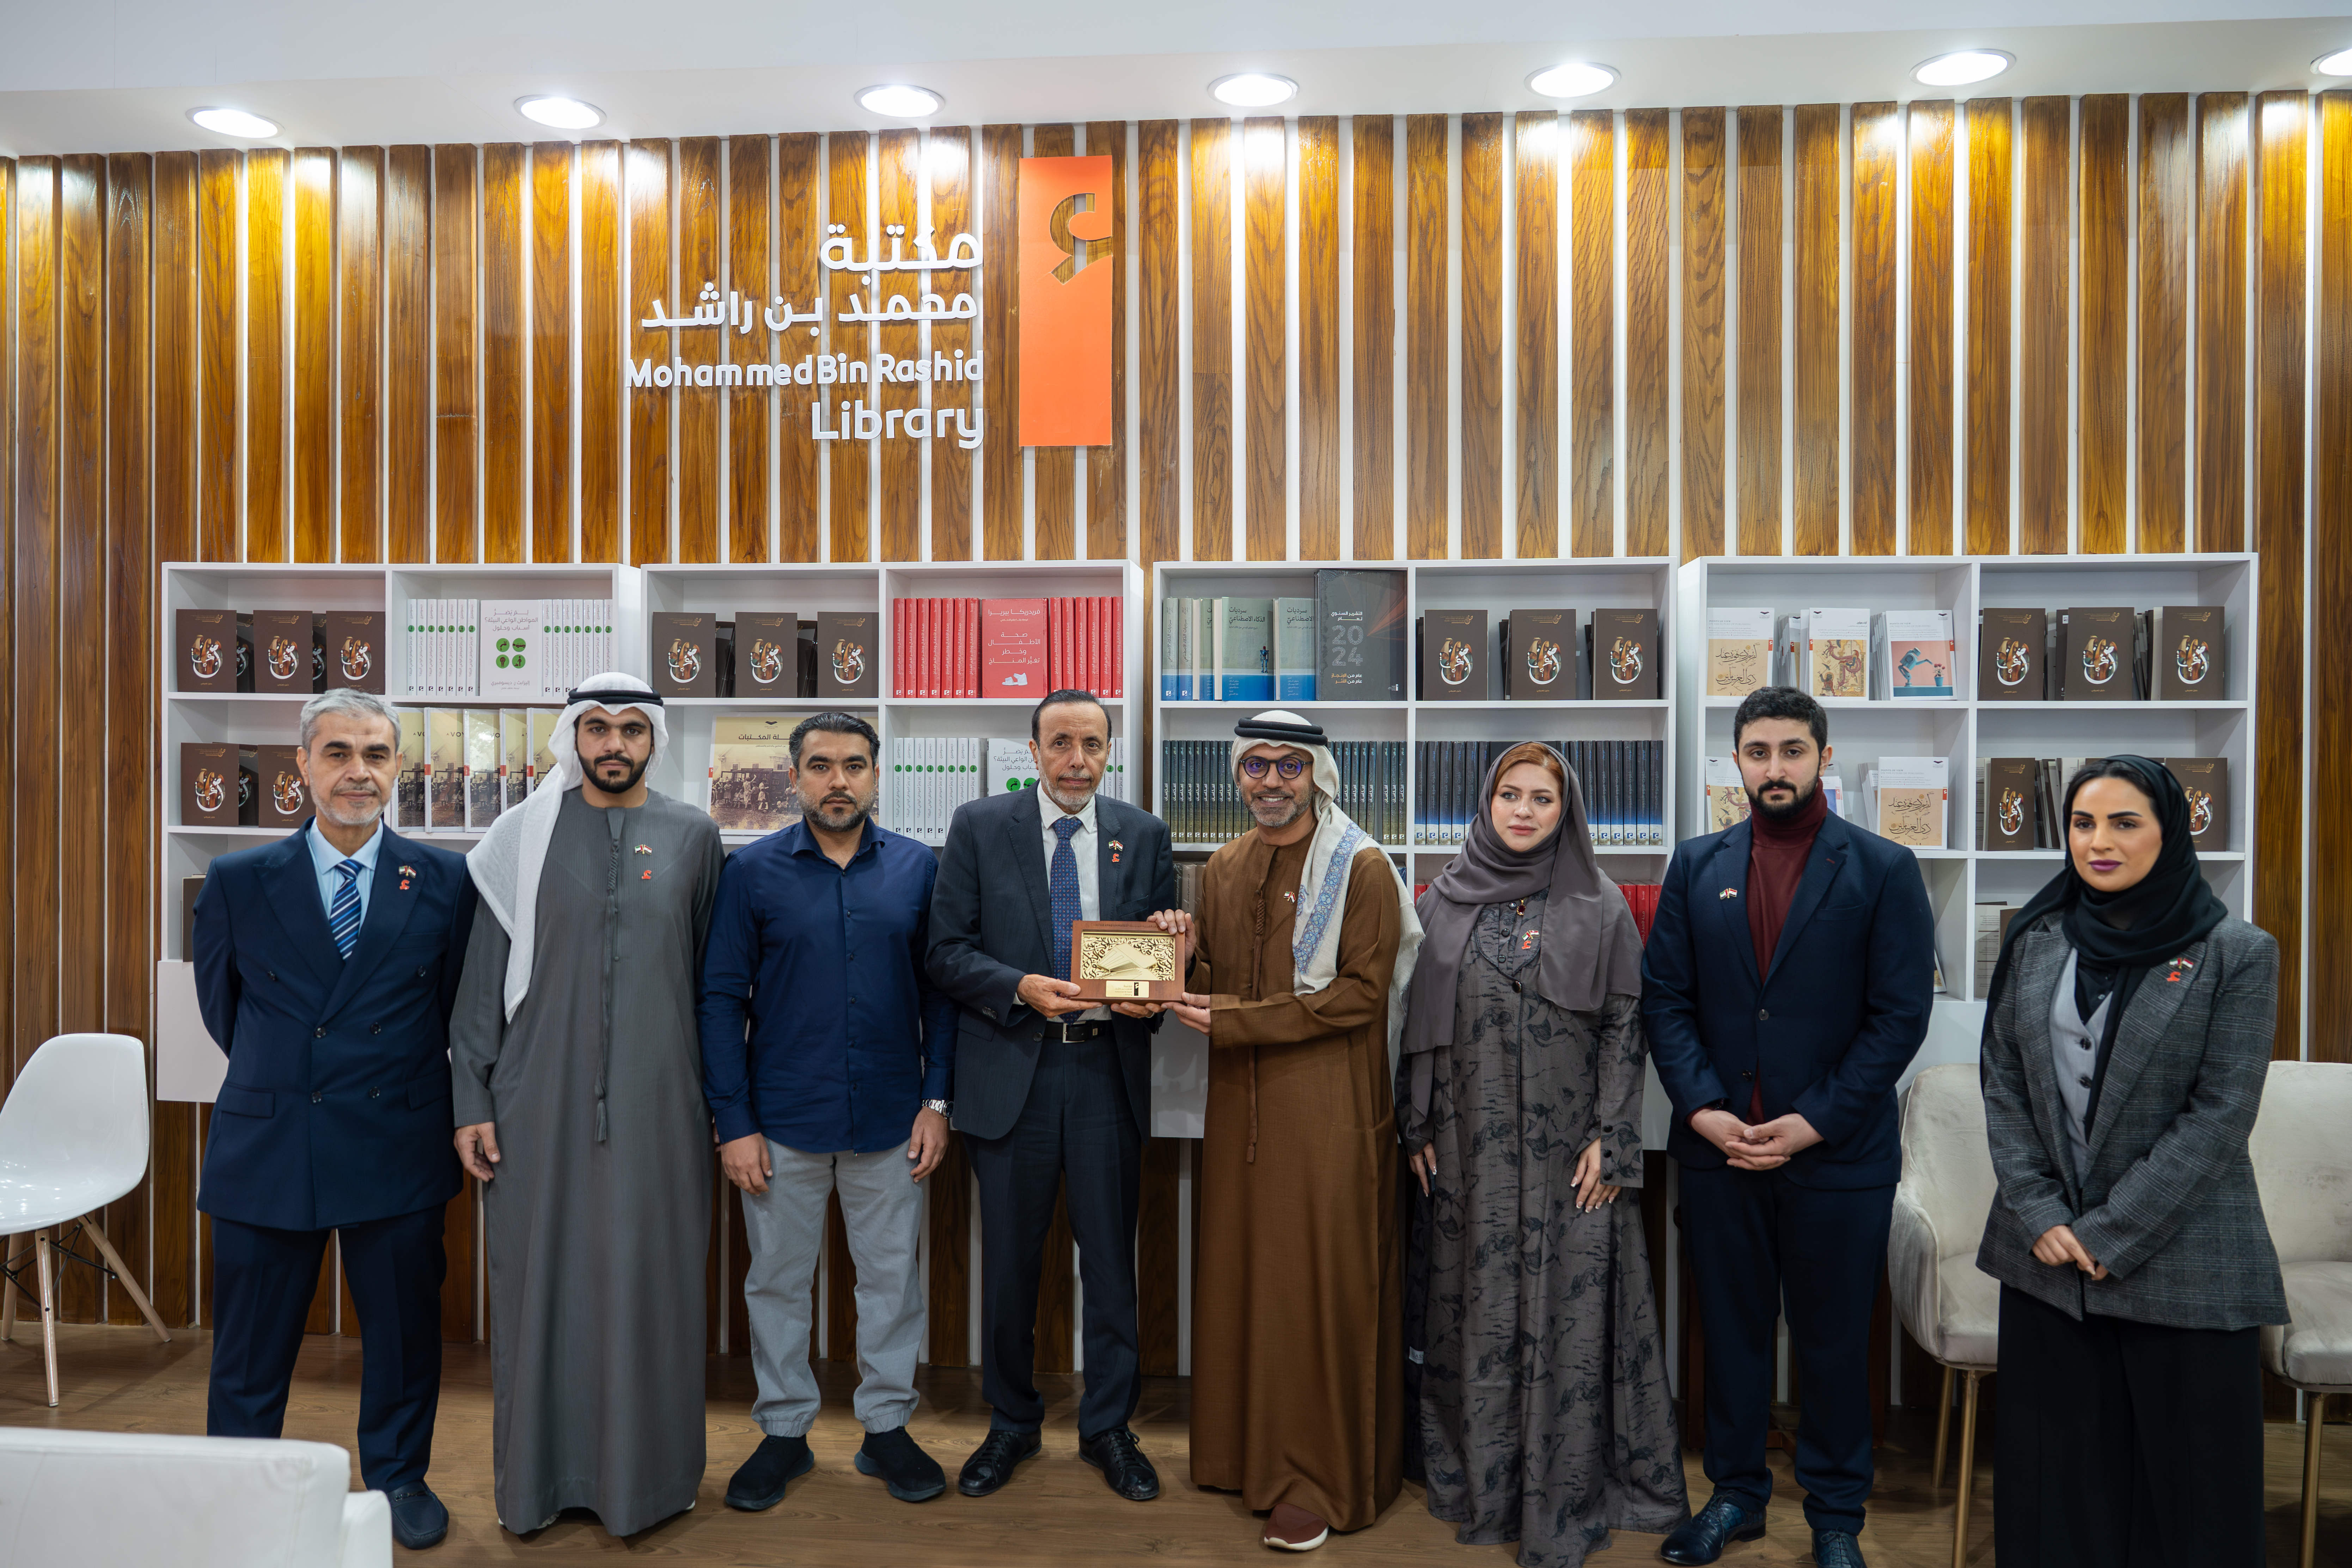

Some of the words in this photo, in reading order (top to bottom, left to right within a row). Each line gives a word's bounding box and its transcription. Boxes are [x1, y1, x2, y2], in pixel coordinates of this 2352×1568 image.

[819, 224, 984, 285] مكتبة
[641, 282, 752, 335] راشد
[765, 295, 823, 337] بن
[838, 288, 978, 322] محمد
[625, 354, 812, 388] Mohammed
[818, 353, 868, 385] Bin
[876, 349, 984, 383] Rashid
[812, 400, 984, 450] Library
[1332, 625, 1364, 645] 20
[1332, 646, 1363, 666] 24
